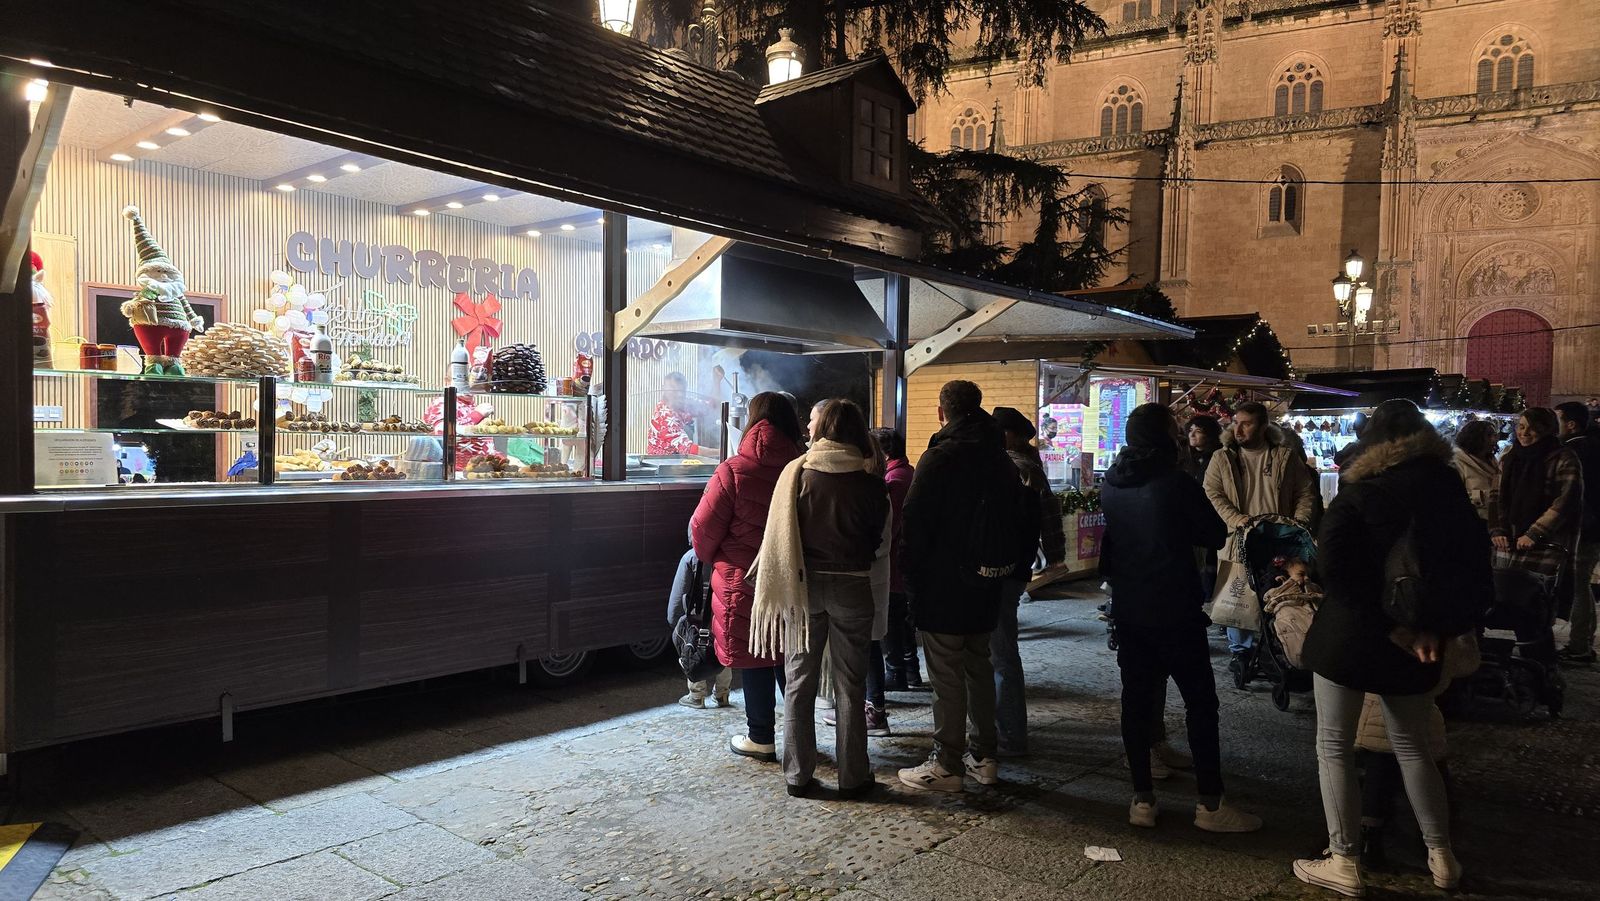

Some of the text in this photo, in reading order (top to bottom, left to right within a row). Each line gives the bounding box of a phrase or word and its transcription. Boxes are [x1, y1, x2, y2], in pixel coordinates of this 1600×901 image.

[286, 231, 540, 301] CHURRERIA
[575, 331, 682, 362] OBADOR
[1045, 453, 1065, 462] PATATAS
[976, 566, 999, 578] JUST
